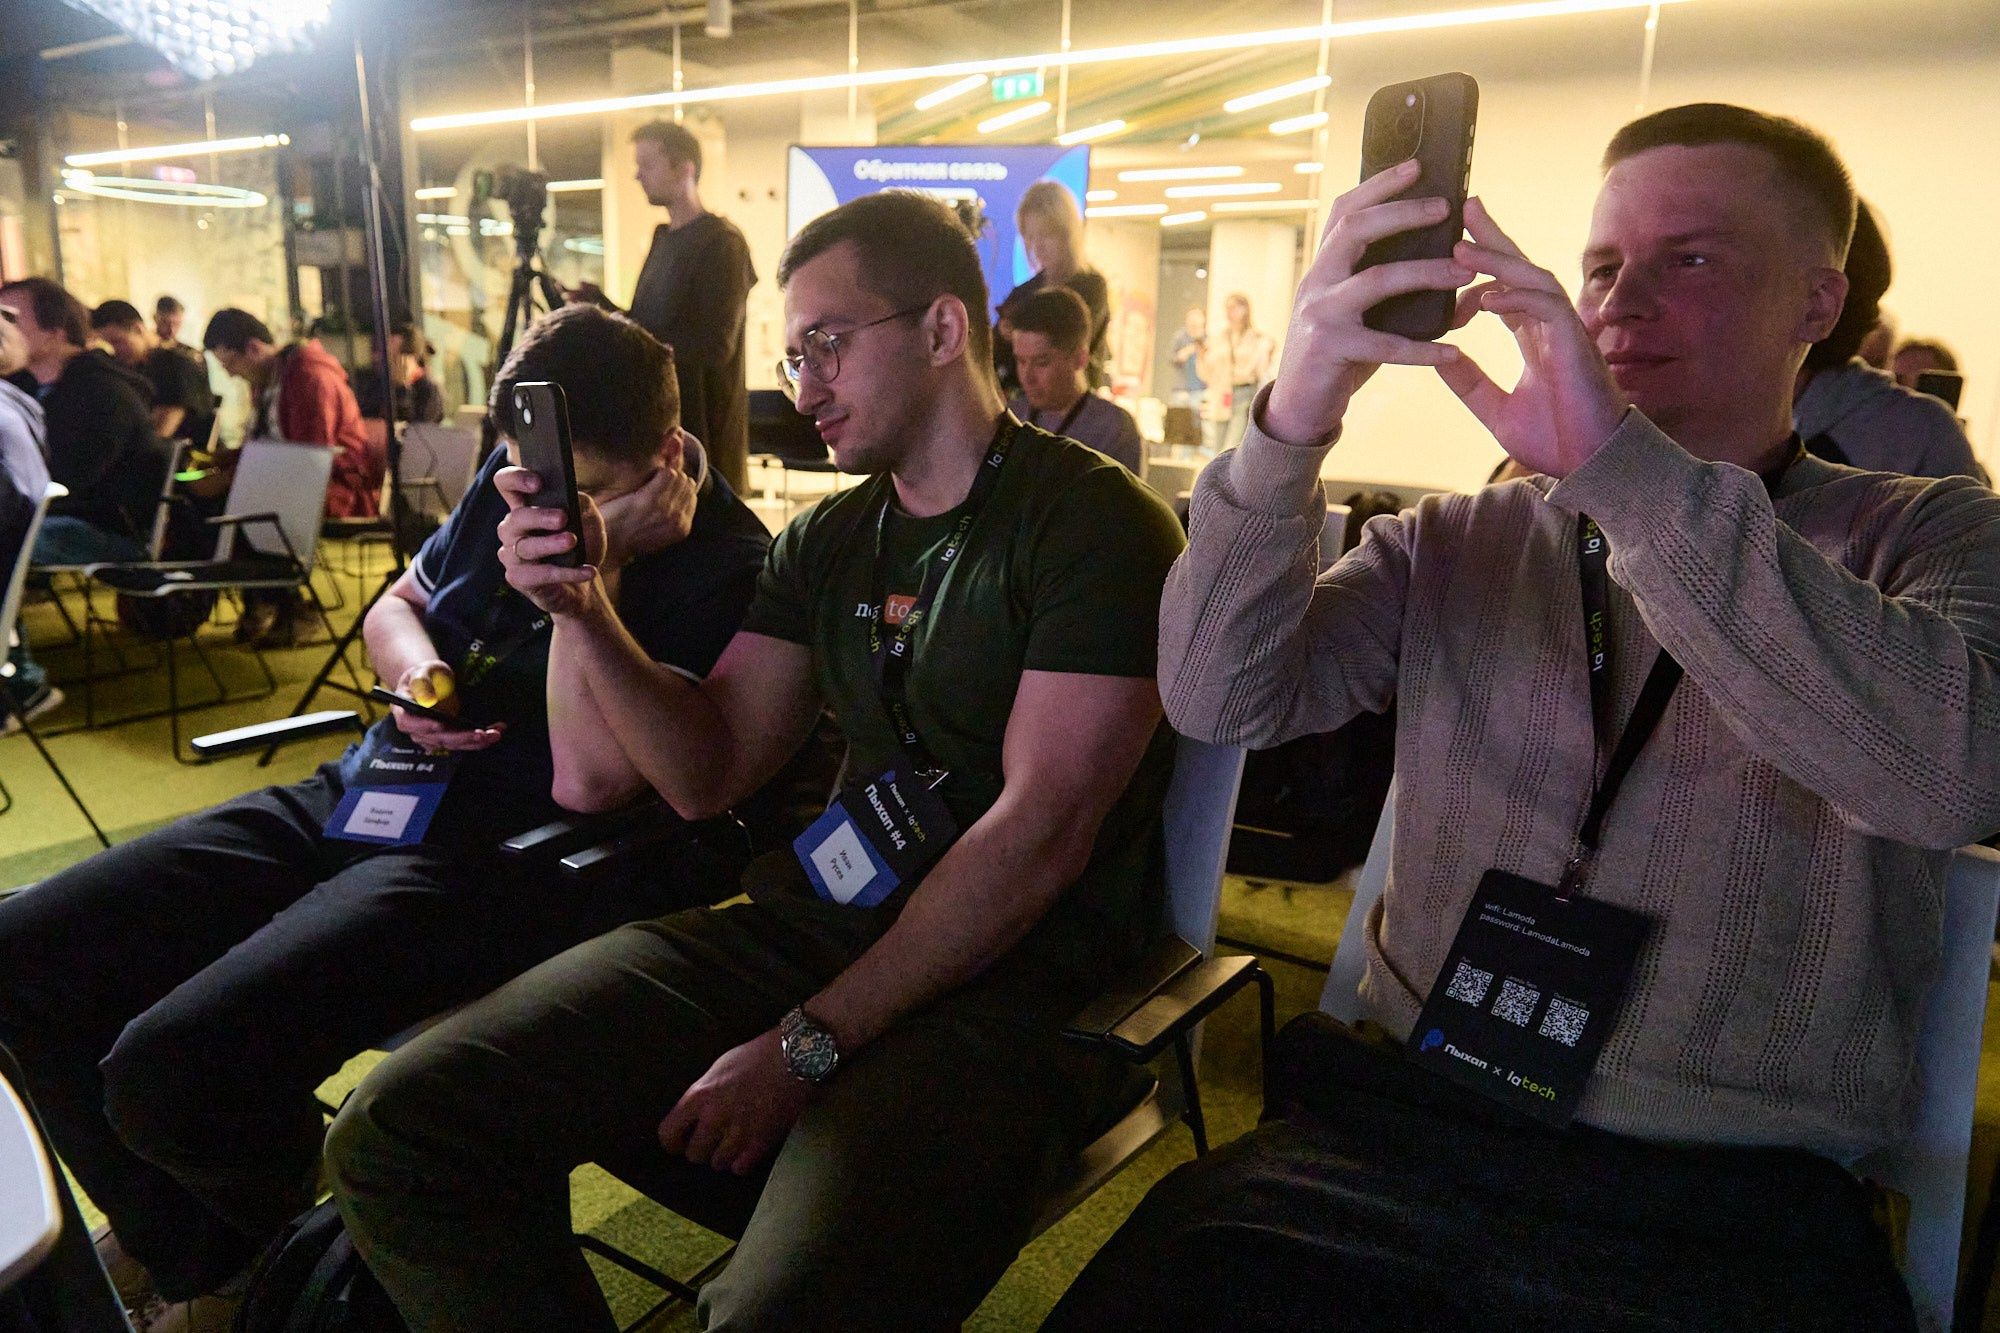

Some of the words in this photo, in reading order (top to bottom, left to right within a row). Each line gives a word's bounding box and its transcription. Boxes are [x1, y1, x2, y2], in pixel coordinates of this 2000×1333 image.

[890, 610, 922, 657] latech
[1589, 611, 1604, 671] latech
[865, 784, 894, 831] Пыхап
[890, 830, 907, 850] #4
[1480, 913, 1520, 932] password:
[1521, 927, 1590, 957] LamodaLamoda
[1502, 908, 1536, 925] Lamoda
[1444, 1044, 1487, 1070] Пыхап
[1506, 1071, 1556, 1100] latech
